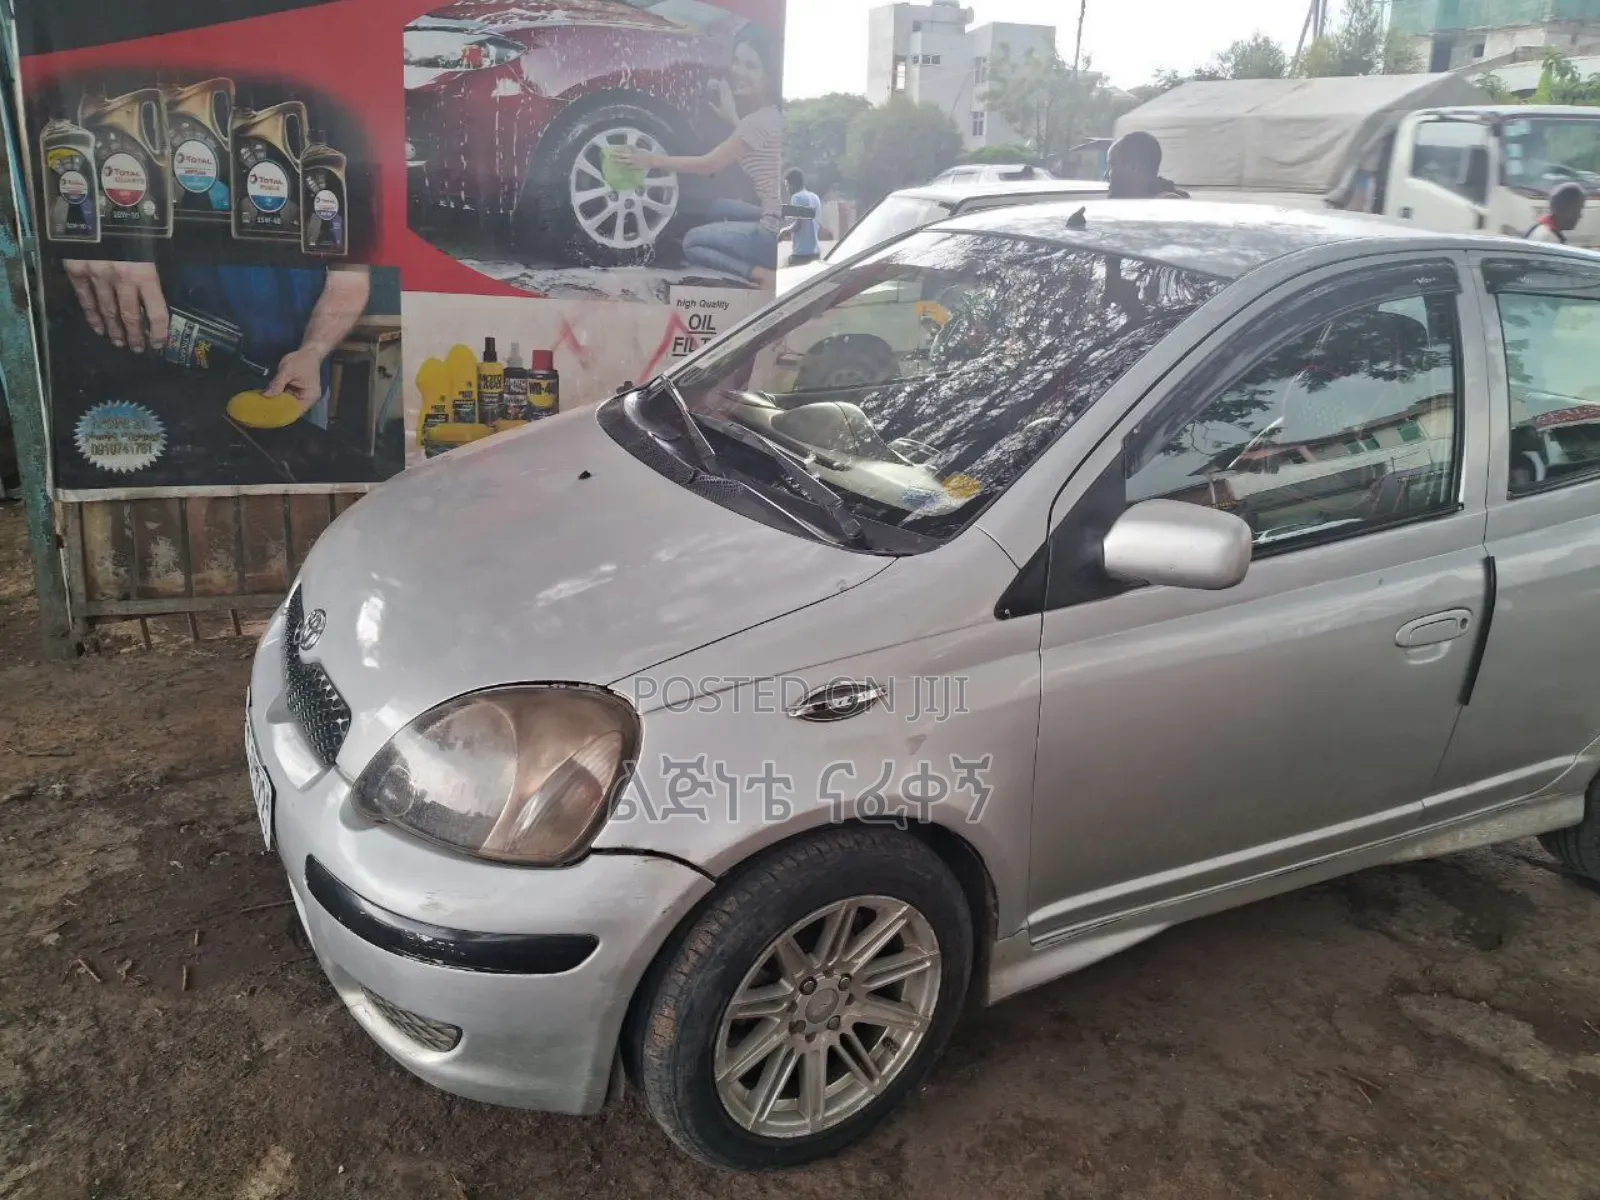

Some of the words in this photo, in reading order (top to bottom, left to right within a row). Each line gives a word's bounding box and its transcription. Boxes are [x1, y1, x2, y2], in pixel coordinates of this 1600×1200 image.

[186, 155, 212, 164] TOTAL
[114, 168, 141, 177] TOTAL
[257, 176, 283, 185] TOTAL
[676, 299, 697, 309] high
[699, 299, 730, 310] Quality
[688, 313, 716, 331] OIL
[672, 337, 712, 353] FILT
